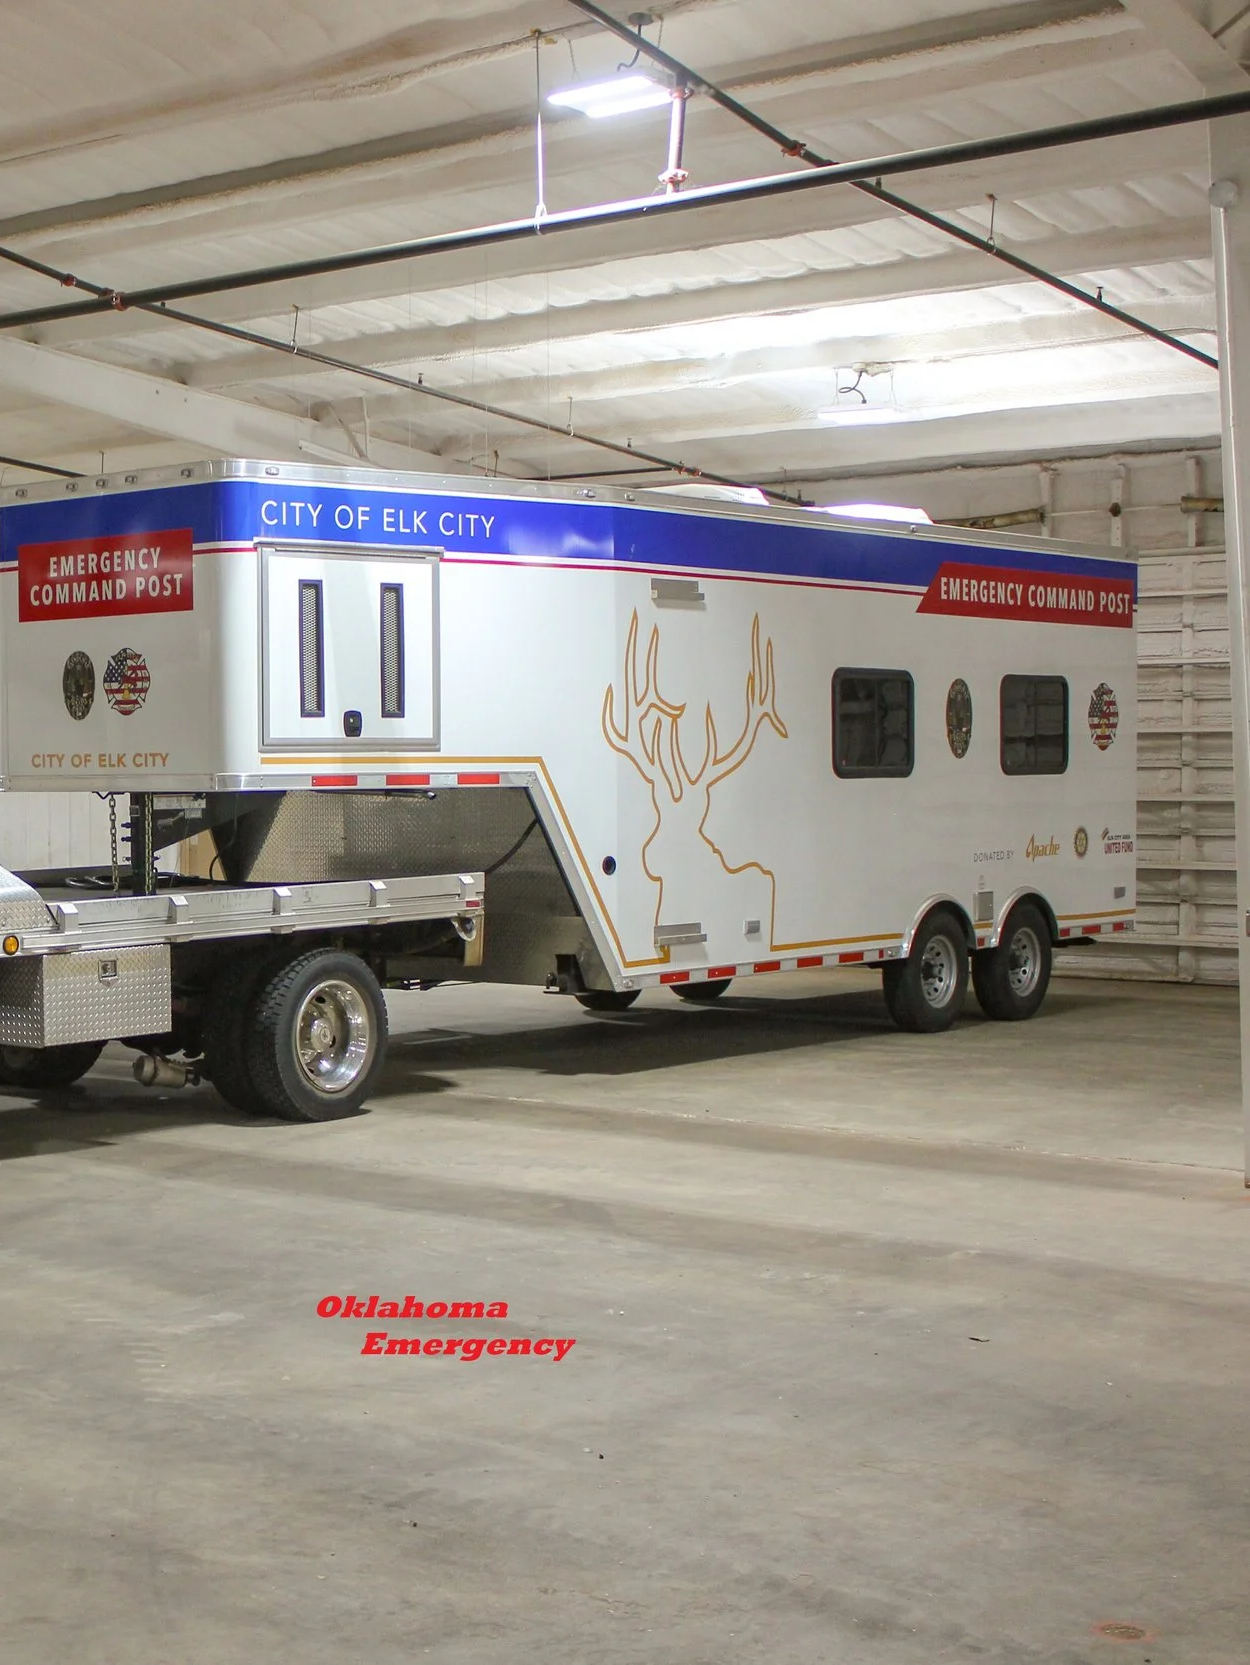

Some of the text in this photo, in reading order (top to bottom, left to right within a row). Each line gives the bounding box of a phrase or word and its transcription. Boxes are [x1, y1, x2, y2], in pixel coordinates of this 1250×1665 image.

[260, 499, 495, 538] CITY OF ELK CITY
[49, 547, 161, 578] EMERGENCY
[30, 573, 183, 607] COMMAND POST
[940, 576, 1130, 615] EMERGENCY COMMAND POST
[31, 752, 170, 769] CITY OF ELK CITY
[973, 849, 1015, 863] DONATED BY
[1025, 832, 1061, 863] Apache
